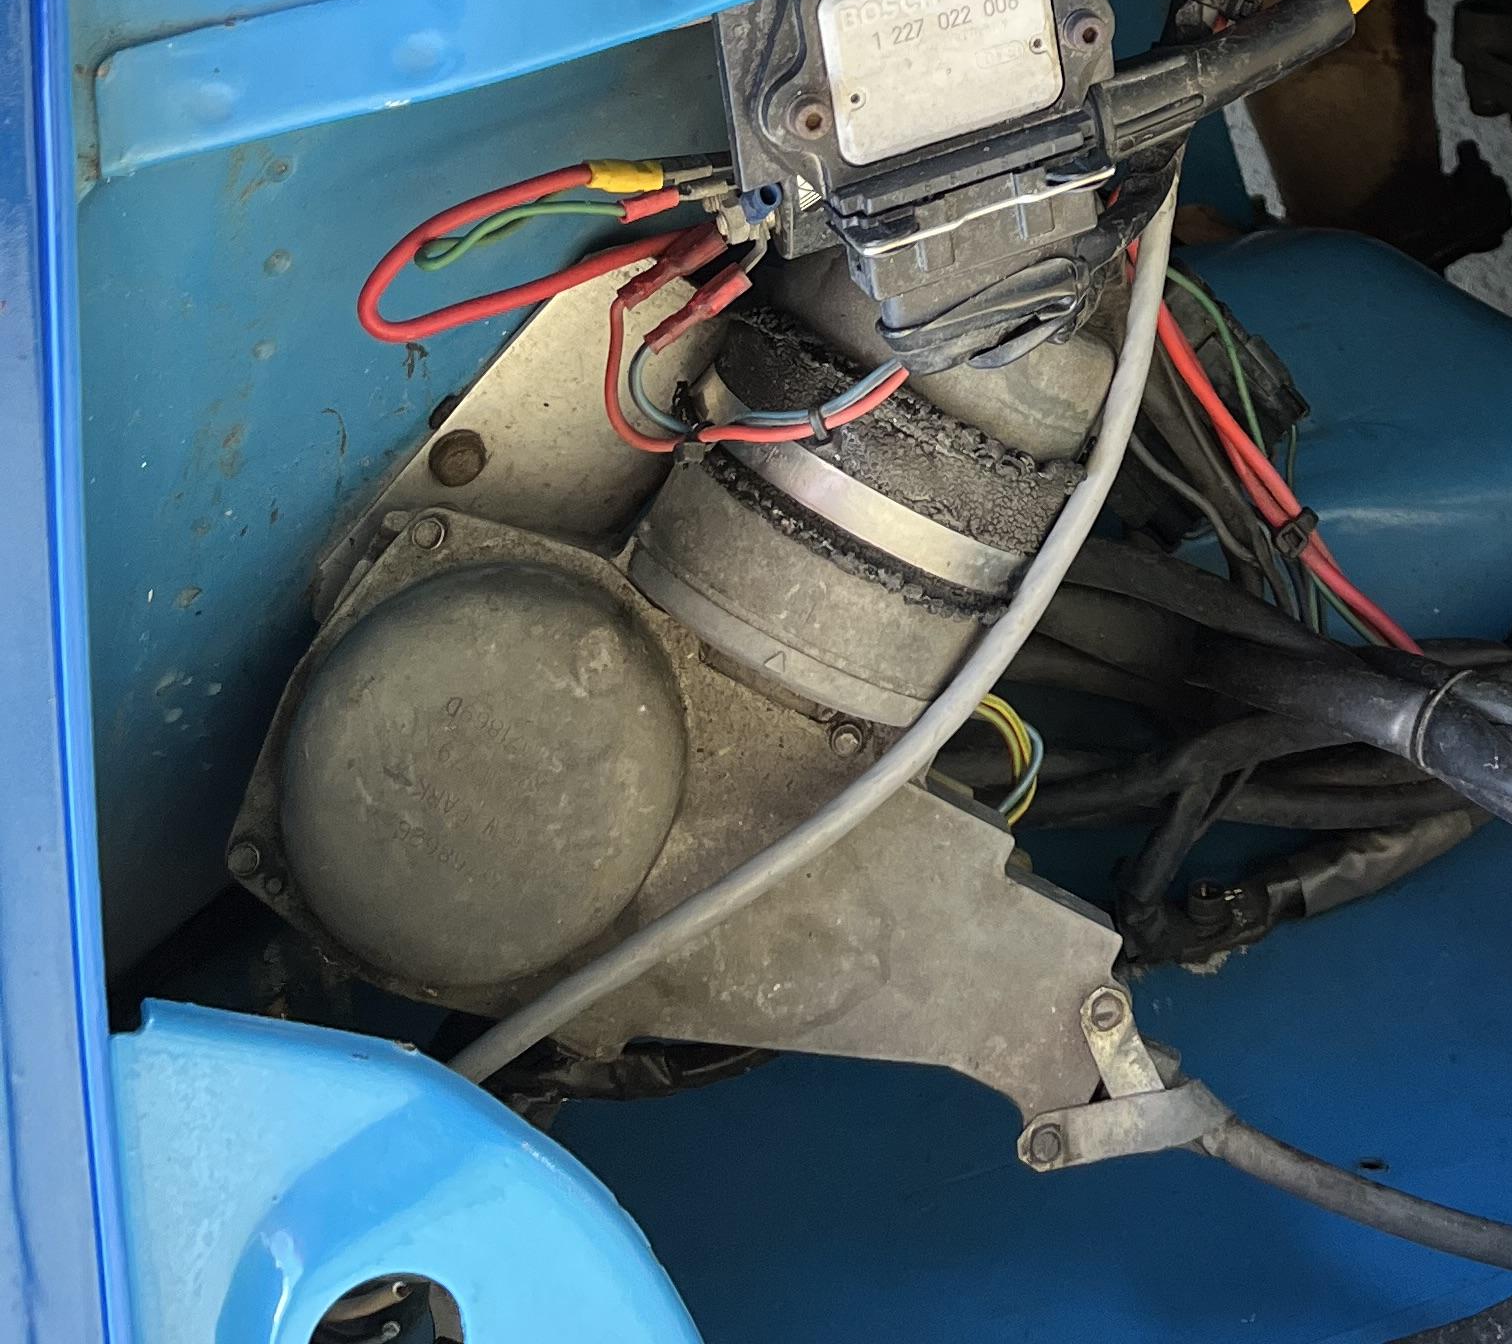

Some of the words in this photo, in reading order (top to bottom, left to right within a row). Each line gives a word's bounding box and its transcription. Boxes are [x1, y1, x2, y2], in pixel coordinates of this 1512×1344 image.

[872, 31, 882, 51] 1
[893, 18, 924, 45] 227
[938, 5, 972, 30] 022
